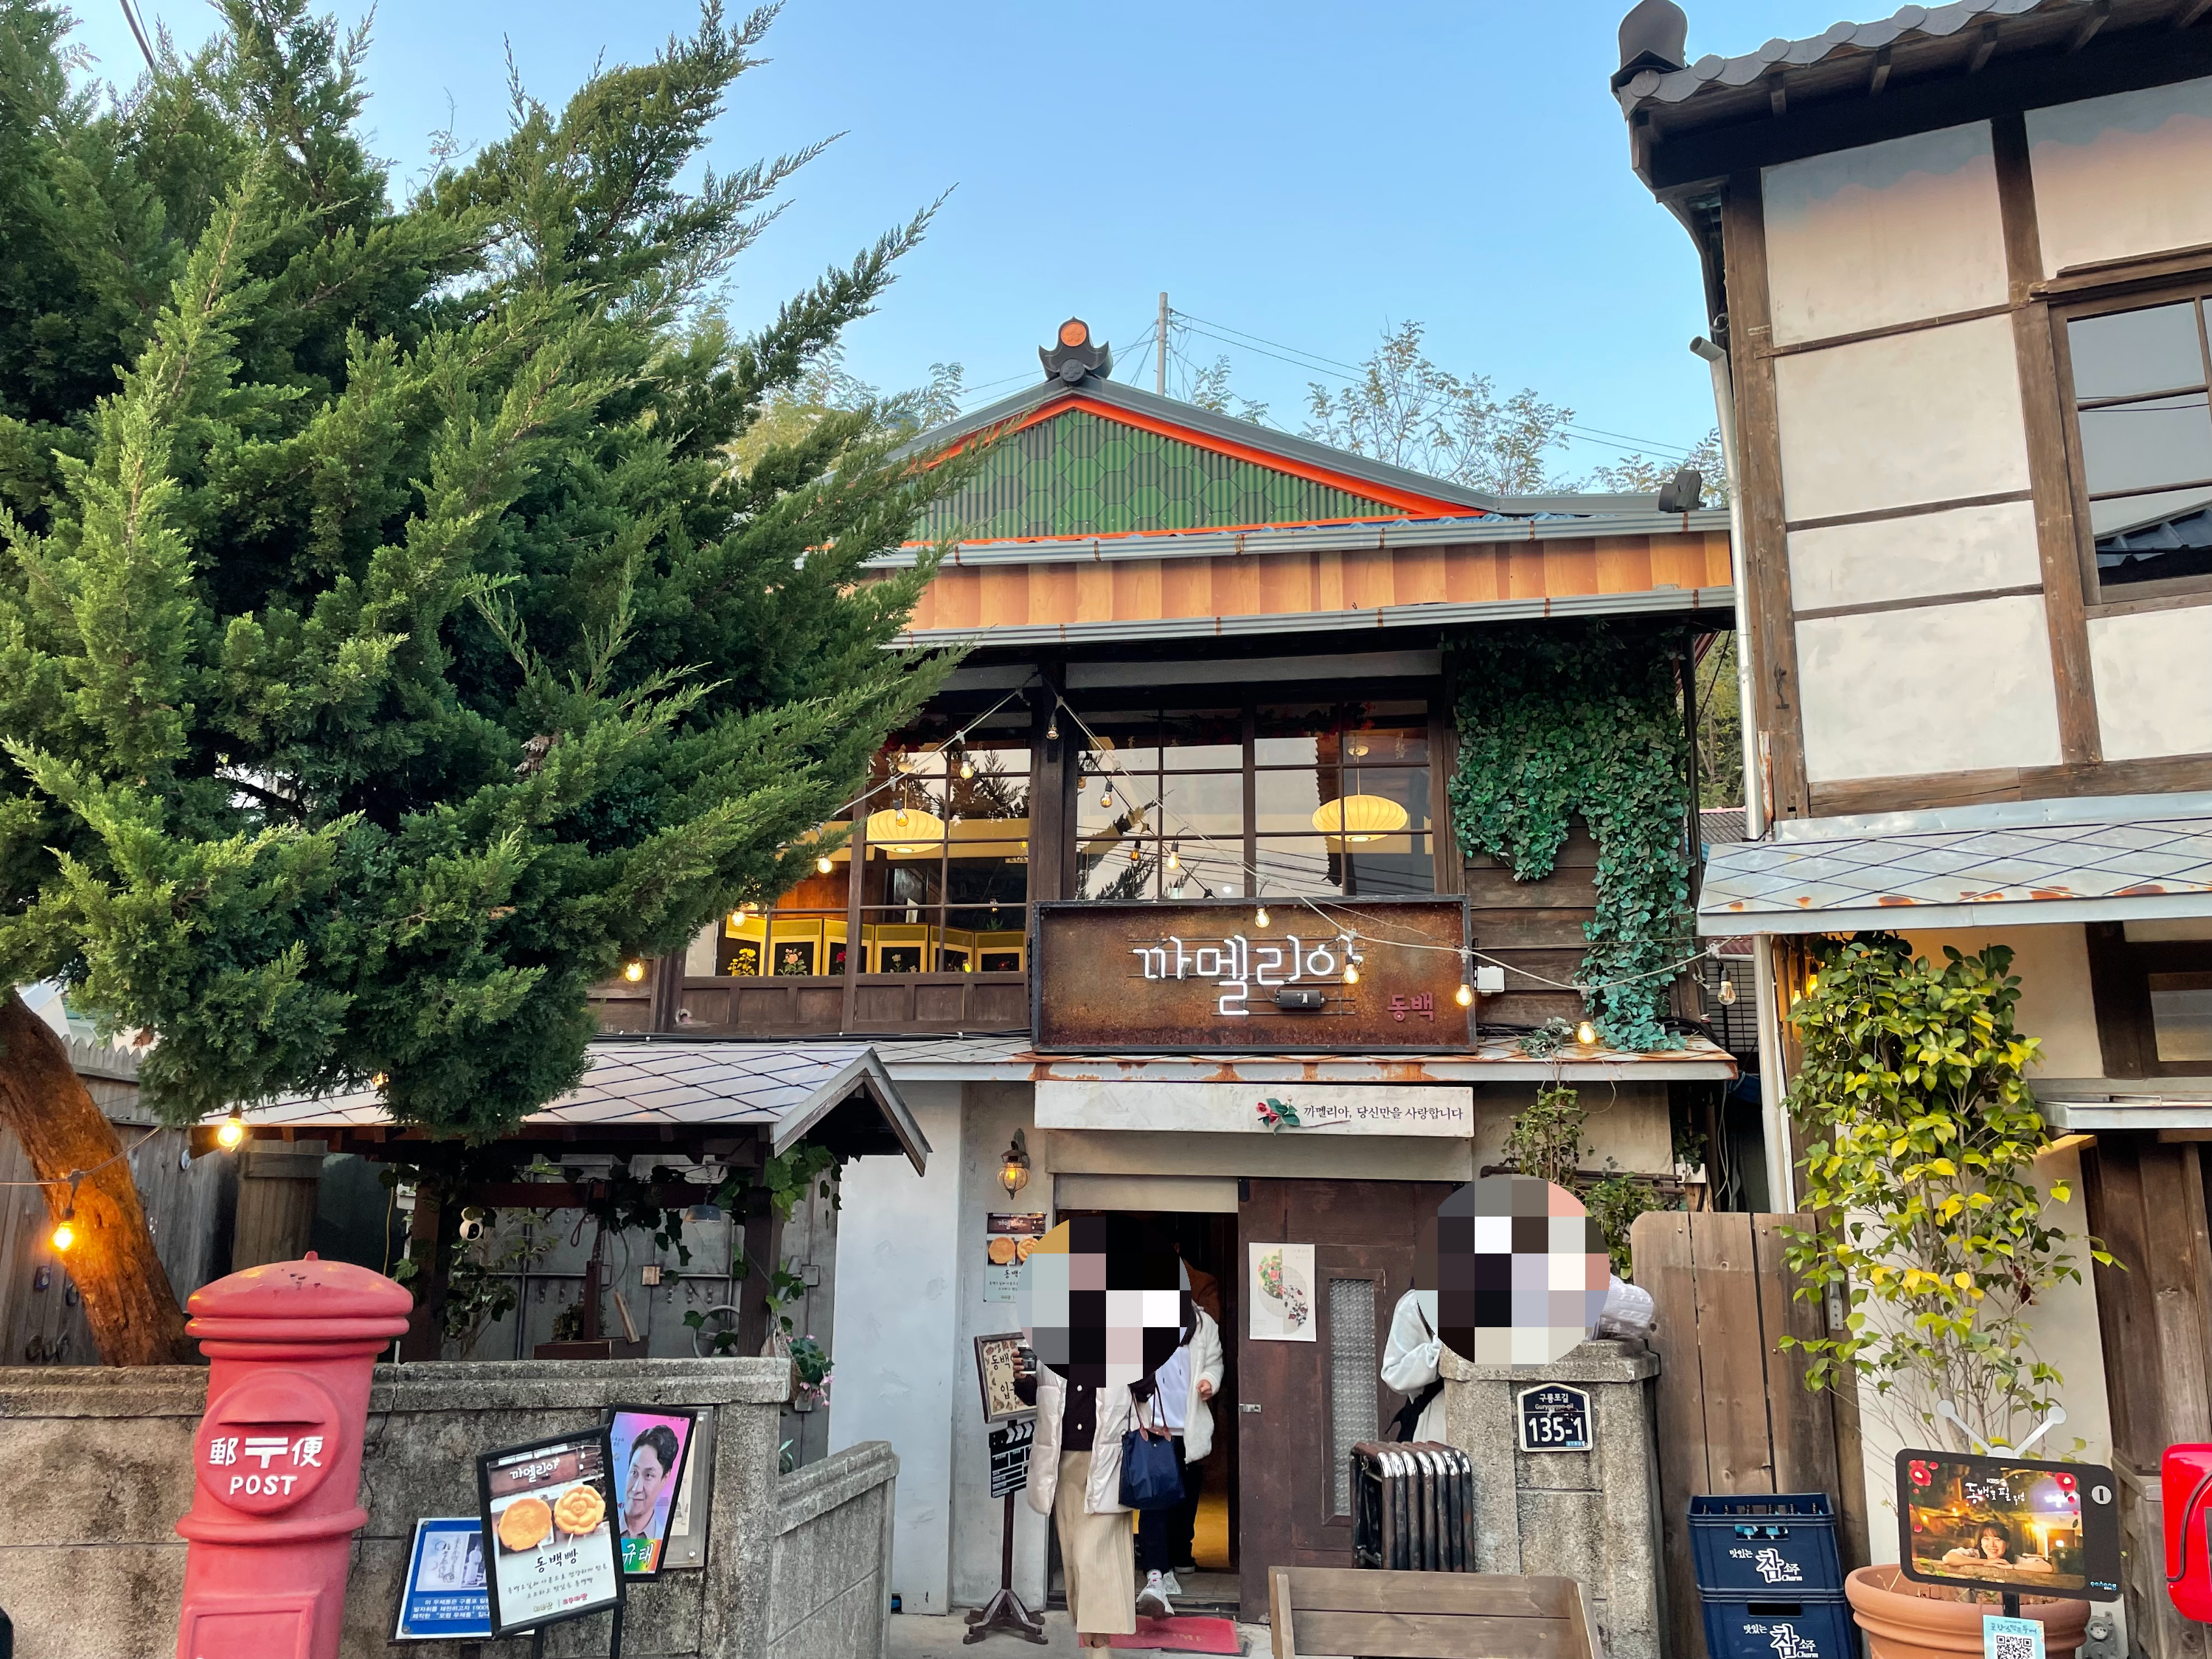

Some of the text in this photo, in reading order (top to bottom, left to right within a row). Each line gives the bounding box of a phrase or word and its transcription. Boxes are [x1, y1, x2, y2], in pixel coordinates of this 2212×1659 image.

[1133, 934, 1363, 1015] 까멜리아
[1387, 991, 1434, 1021] 동백
[1304, 1105, 1464, 1120] 까멜리아, 당신만을 사랑합니다
[1004, 1270, 1020, 1279] 동백
[1539, 1393, 1568, 1403] 구룡포길
[1528, 1416, 1583, 1442] 135-1
[229, 1475, 298, 1495] POST
[1729, 1548, 1801, 1583] 맛있는 참 소주
[1743, 1623, 1816, 1659] 맛있는 참 소주
